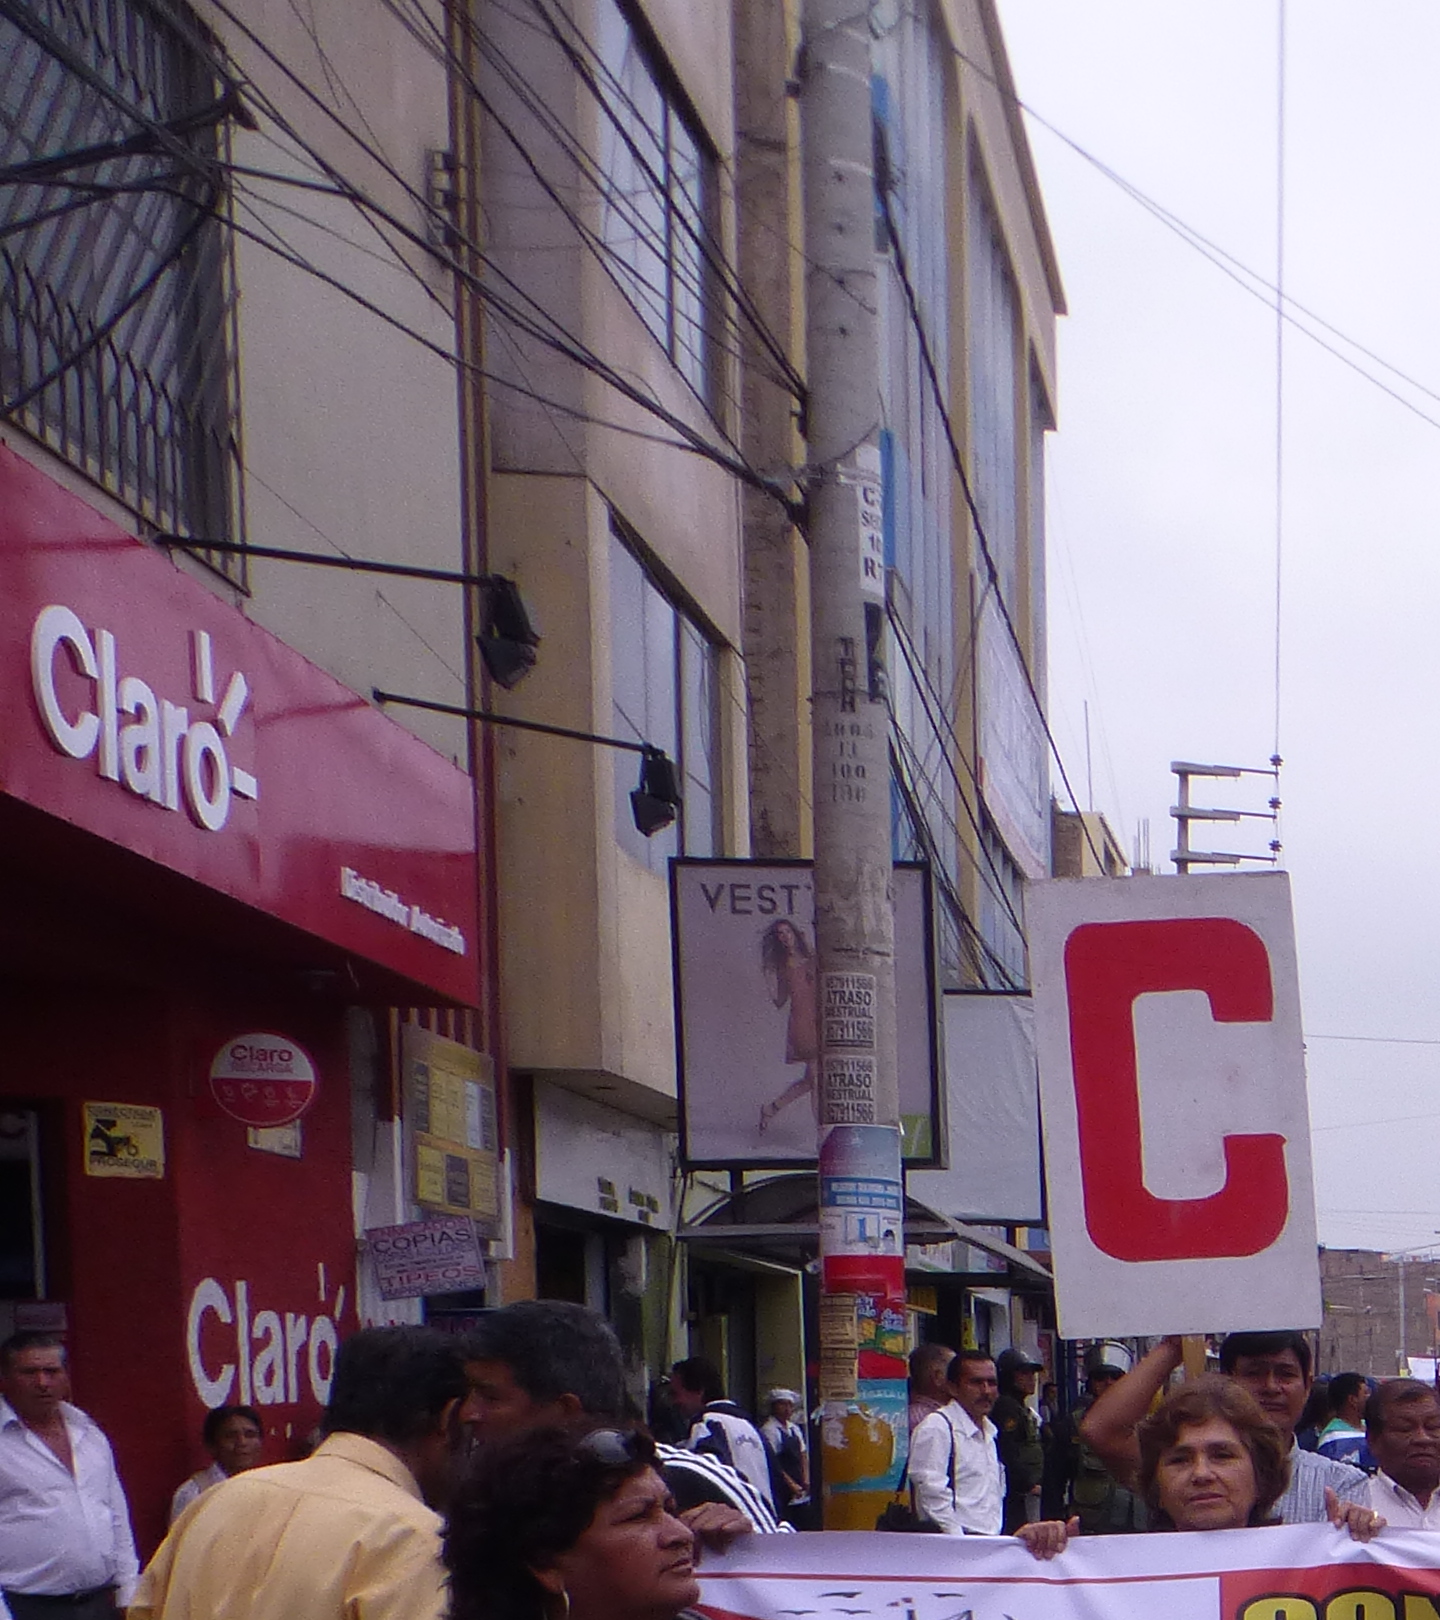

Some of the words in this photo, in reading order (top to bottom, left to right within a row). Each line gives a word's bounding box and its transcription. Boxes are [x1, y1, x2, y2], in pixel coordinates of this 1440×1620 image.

[31, 604, 232, 831] Claro
[700, 883, 813, 915] VEST
[827, 990, 872, 1006] ATRASO
[230, 1045, 294, 1062] Claro
[828, 1073, 872, 1089] ATRASO
[1064, 917, 1288, 1262] C
[373, 1229, 471, 1253] COPIAS
[381, 1266, 480, 1287] TIPEOS
[187, 1277, 338, 1408] Claro
